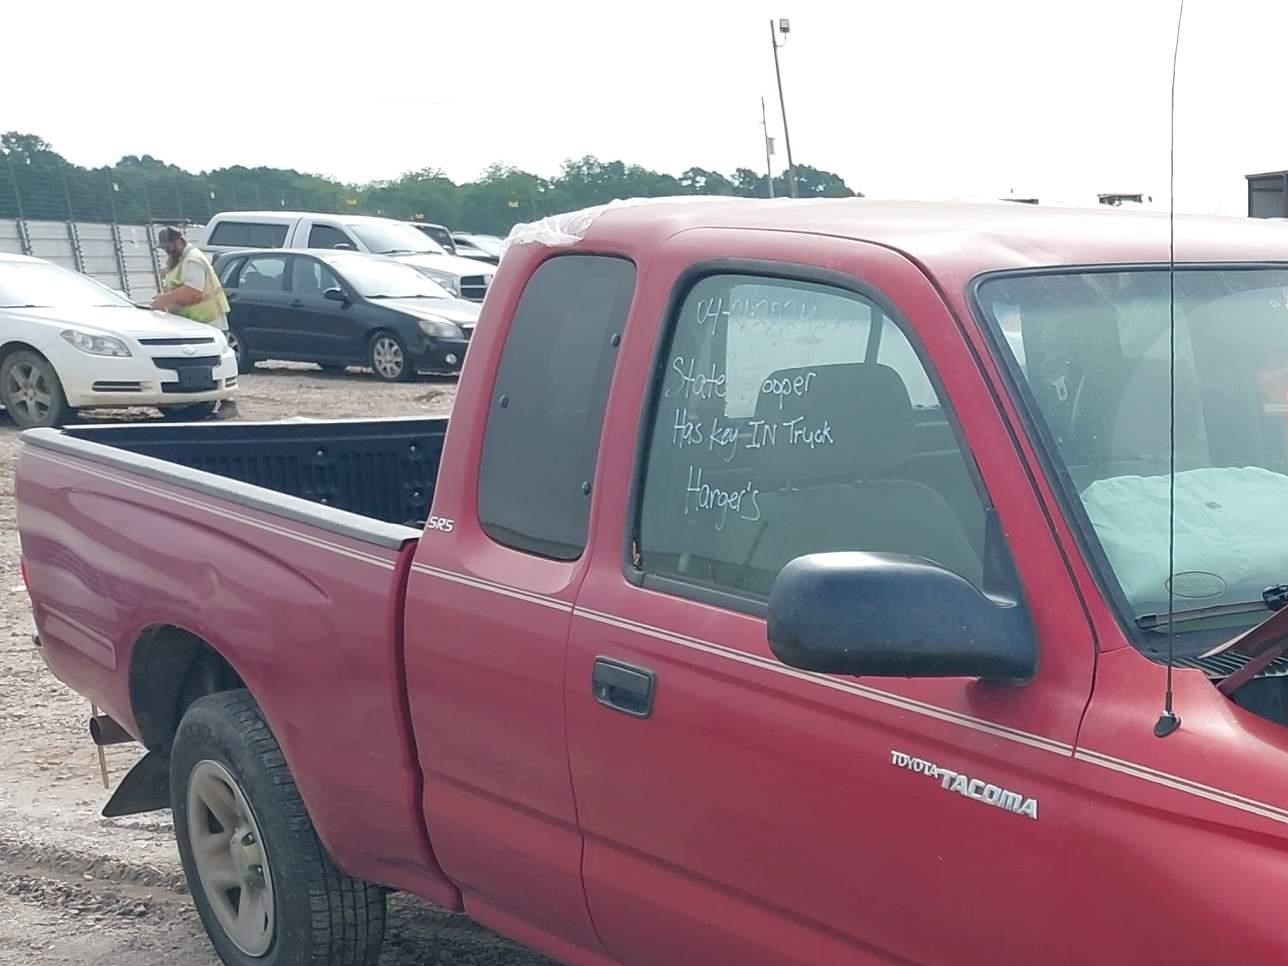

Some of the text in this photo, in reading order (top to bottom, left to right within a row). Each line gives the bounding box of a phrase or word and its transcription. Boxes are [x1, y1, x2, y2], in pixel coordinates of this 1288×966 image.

[665, 356, 728, 400] State
[672, 408, 704, 449] Has
[744, 419, 778, 449] IN
[781, 416, 834, 451] Truck
[427, 515, 455, 532] SR5
[890, 750, 1040, 820] TOYOTA TACOMA
